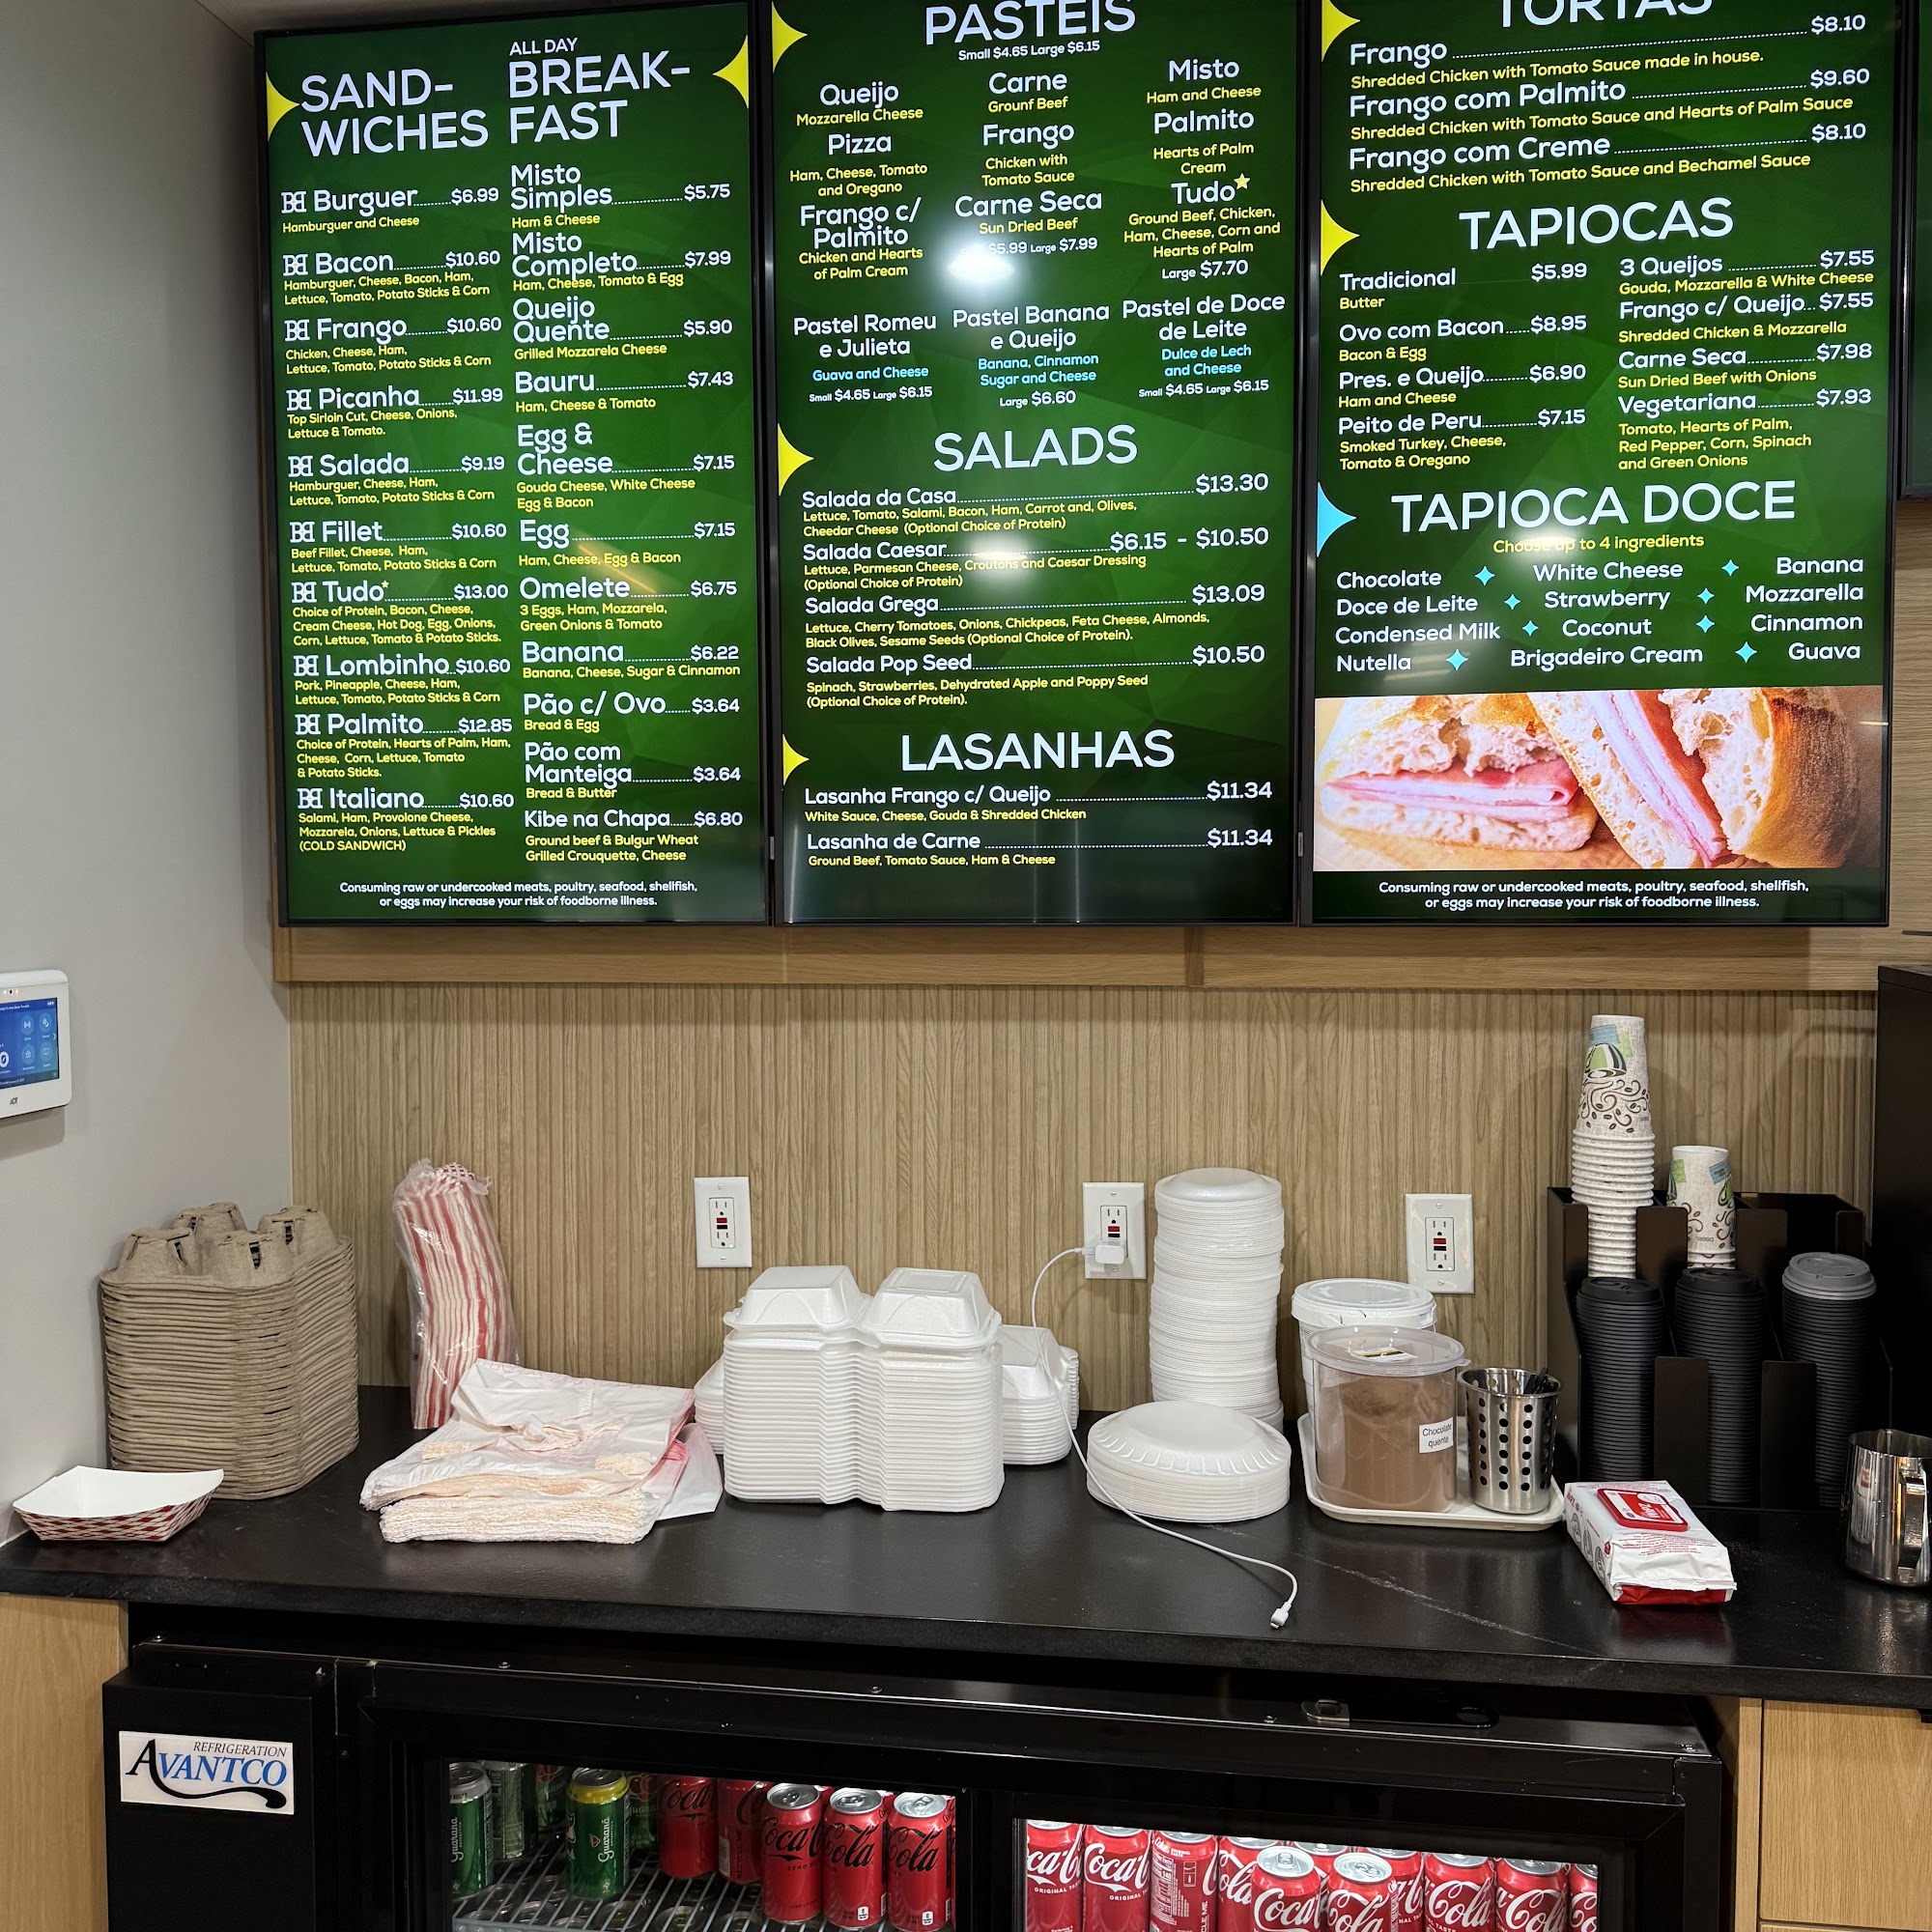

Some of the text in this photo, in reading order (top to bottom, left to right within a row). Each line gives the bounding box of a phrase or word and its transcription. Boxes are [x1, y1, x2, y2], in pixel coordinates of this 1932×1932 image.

[925, 0, 1136, 45] PASTEIS
[1810, 14, 1866, 36] $8.10
[508, 37, 579, 57] ALL DAY
[958, 40, 1100, 61] Small $4.65 Large $6.15
[1350, 43, 1448, 70] Frango
[508, 49, 691, 99] BREAK-
[1169, 58, 1240, 82] Misto
[1809, 68, 1870, 89] $9.60
[300, 68, 454, 113] SAND-
[988, 71, 1067, 95] Carne
[819, 80, 899, 109] Queijo
[987, 96, 1067, 113] Grounf Beef
[1350, 79, 1627, 122] Frango com Palmito
[509, 99, 628, 145] FAST
[796, 108, 924, 127] Mozzarella Cheese
[1153, 107, 1255, 134] Palmito
[300, 109, 489, 157] WICHES
[828, 132, 892, 156] Pizza
[982, 124, 1075, 151] Frango
[1153, 142, 1255, 160] Hearts of Palm
[511, 163, 582, 188] Misto
[313, 189, 419, 217] Burguer
[450, 186, 499, 207] $6.99
[510, 184, 612, 213] Simples
[683, 183, 731, 203] $5.75
[282, 216, 420, 235] Hamburguer and Cheese
[511, 213, 601, 229] Ham & Cheese
[1458, 196, 1734, 250] TAPIOCAS
[315, 252, 394, 275] Bacon
[445, 249, 501, 270] $10.60
[511, 250, 639, 280] Completo
[684, 249, 731, 270] $7.99
[1339, 267, 1456, 292] Tradicional
[1530, 262, 1587, 283] $5.99
[512, 295, 596, 324] Queijo
[1339, 297, 1385, 310] Butter
[317, 317, 408, 345] Frango
[446, 316, 502, 335] $10.60
[513, 318, 611, 344] Quente
[683, 319, 733, 338] $5.90
[793, 313, 937, 336] Pastel Romeu
[285, 345, 407, 360] Chicken, Cheese, Ham,
[513, 343, 668, 360] Grilled Mozzarela Cheese
[1618, 347, 1747, 370] Carne Seca
[1816, 342, 1873, 363] $7.98
[515, 370, 595, 394] Bauru
[687, 370, 734, 389] $7.43
[811, 366, 929, 382] Guava and Cheese
[318, 384, 421, 411] Picanha
[452, 387, 503, 406] $11.99
[1617, 392, 1756, 419] Vegetariana
[1815, 387, 1872, 408] $7.93
[287, 425, 385, 440] Lettuce & Tomato.
[933, 424, 1138, 472] SALADS
[319, 451, 410, 477] Salada
[461, 455, 505, 474] $9.19
[1195, 472, 1269, 497] $13.30
[802, 487, 956, 509] Salada da Casa
[1391, 479, 1796, 533] TAPIOCA DOCE
[322, 520, 384, 543] Fillet
[451, 523, 507, 541] $10.60
[520, 519, 570, 550] Egg
[694, 521, 736, 540] $7.15
[1533, 561, 1684, 582] White Cheese
[1776, 556, 1864, 575] Banana
[519, 575, 632, 600] Omelete
[690, 580, 738, 598] $6.75
[1336, 569, 1442, 589] Chocolate
[1191, 583, 1265, 607] $13.09
[1544, 588, 1671, 611] Strawberry
[1746, 582, 1864, 604] Mozzarella
[805, 594, 939, 618] Salada Grega
[1562, 618, 1653, 638] Coconut
[1750, 613, 1863, 633] Cinnamon
[522, 640, 624, 664] Banana
[690, 643, 740, 663] $6.22
[1192, 644, 1265, 668] $10.50
[1336, 652, 1412, 672] Nutella
[1510, 645, 1703, 672] Brigadeiro Cream
[1788, 641, 1861, 661] Guava
[326, 652, 450, 676] Lombinho
[455, 657, 511, 676] $10.60
[806, 652, 973, 676] Salada Pop Seed
[327, 712, 424, 735] Palmito
[458, 717, 513, 735] $12.85
[901, 728, 1175, 772] LASANHAS
[525, 762, 633, 788] Manteiga
[693, 765, 742, 783] $3.64
[329, 786, 425, 810] Italiano
[458, 791, 515, 810] $10.60
[298, 838, 407, 852] (COLD SANDWICH)
[807, 832, 981, 850] Lasanha de Carne
[1207, 827, 1273, 849] $11.34
[525, 849, 687, 865] Grilled Crouquette, Cheese
[339, 880, 698, 896] Consuming raw or undercooked meats, poultry, seafood, shellfish,
[1422, 1423, 1452, 1437] Chocolate
[1428, 1436, 1449, 1448] quente
[193, 1741, 288, 1758] REFRIGERATION
[125, 1738, 287, 1799] AVANTCO
[1034, 1886, 1067, 1894] ORIGINAL
